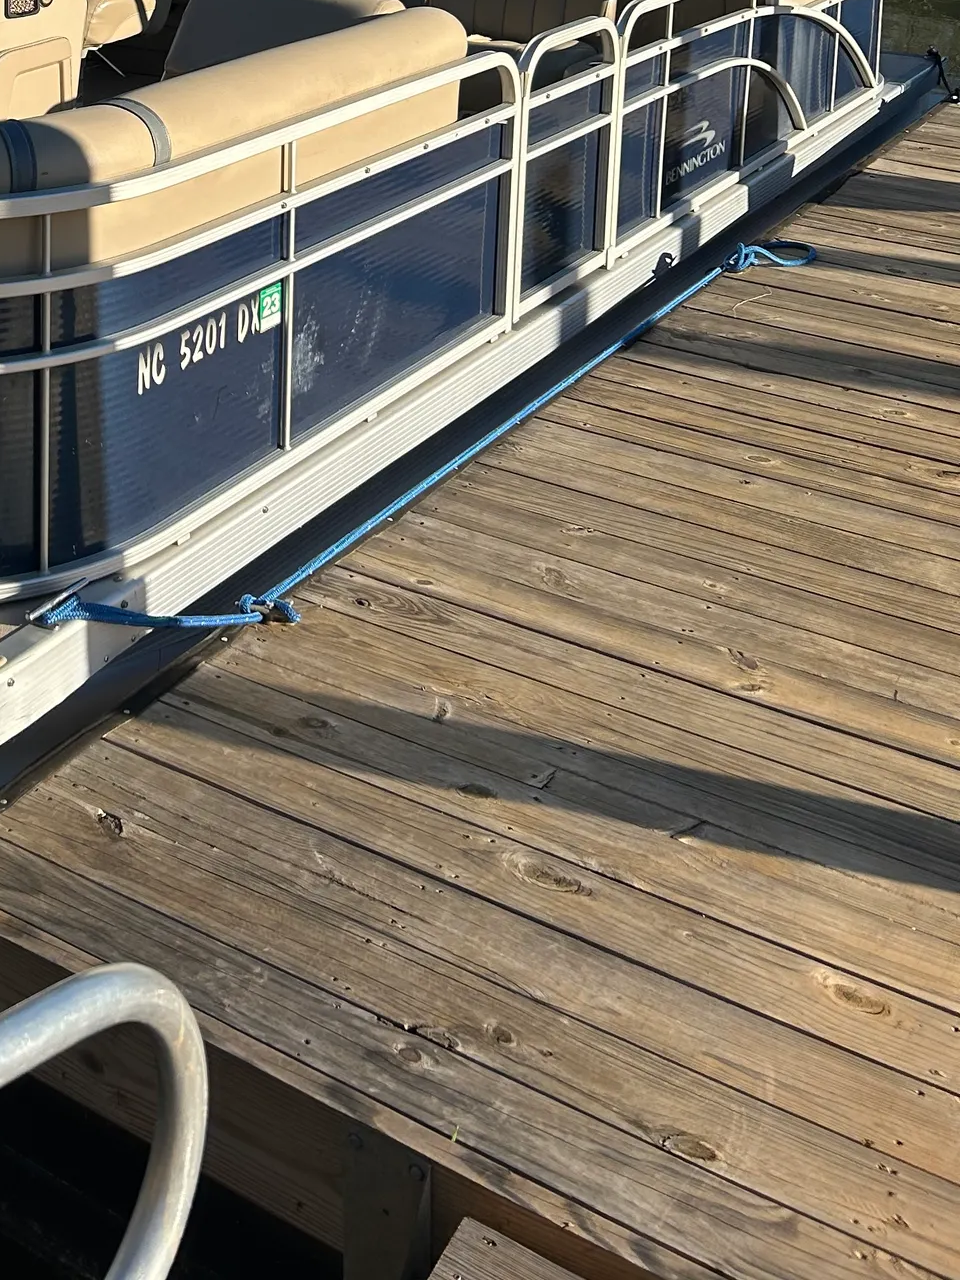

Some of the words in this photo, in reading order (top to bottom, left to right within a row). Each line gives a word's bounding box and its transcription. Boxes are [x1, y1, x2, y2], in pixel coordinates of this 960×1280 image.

[665, 140, 726, 186] BENNINGTON
[262, 292, 281, 318] 23
[137, 342, 166, 396] NC
[180, 311, 227, 371] 5201
[237, 294, 260, 343] DX
